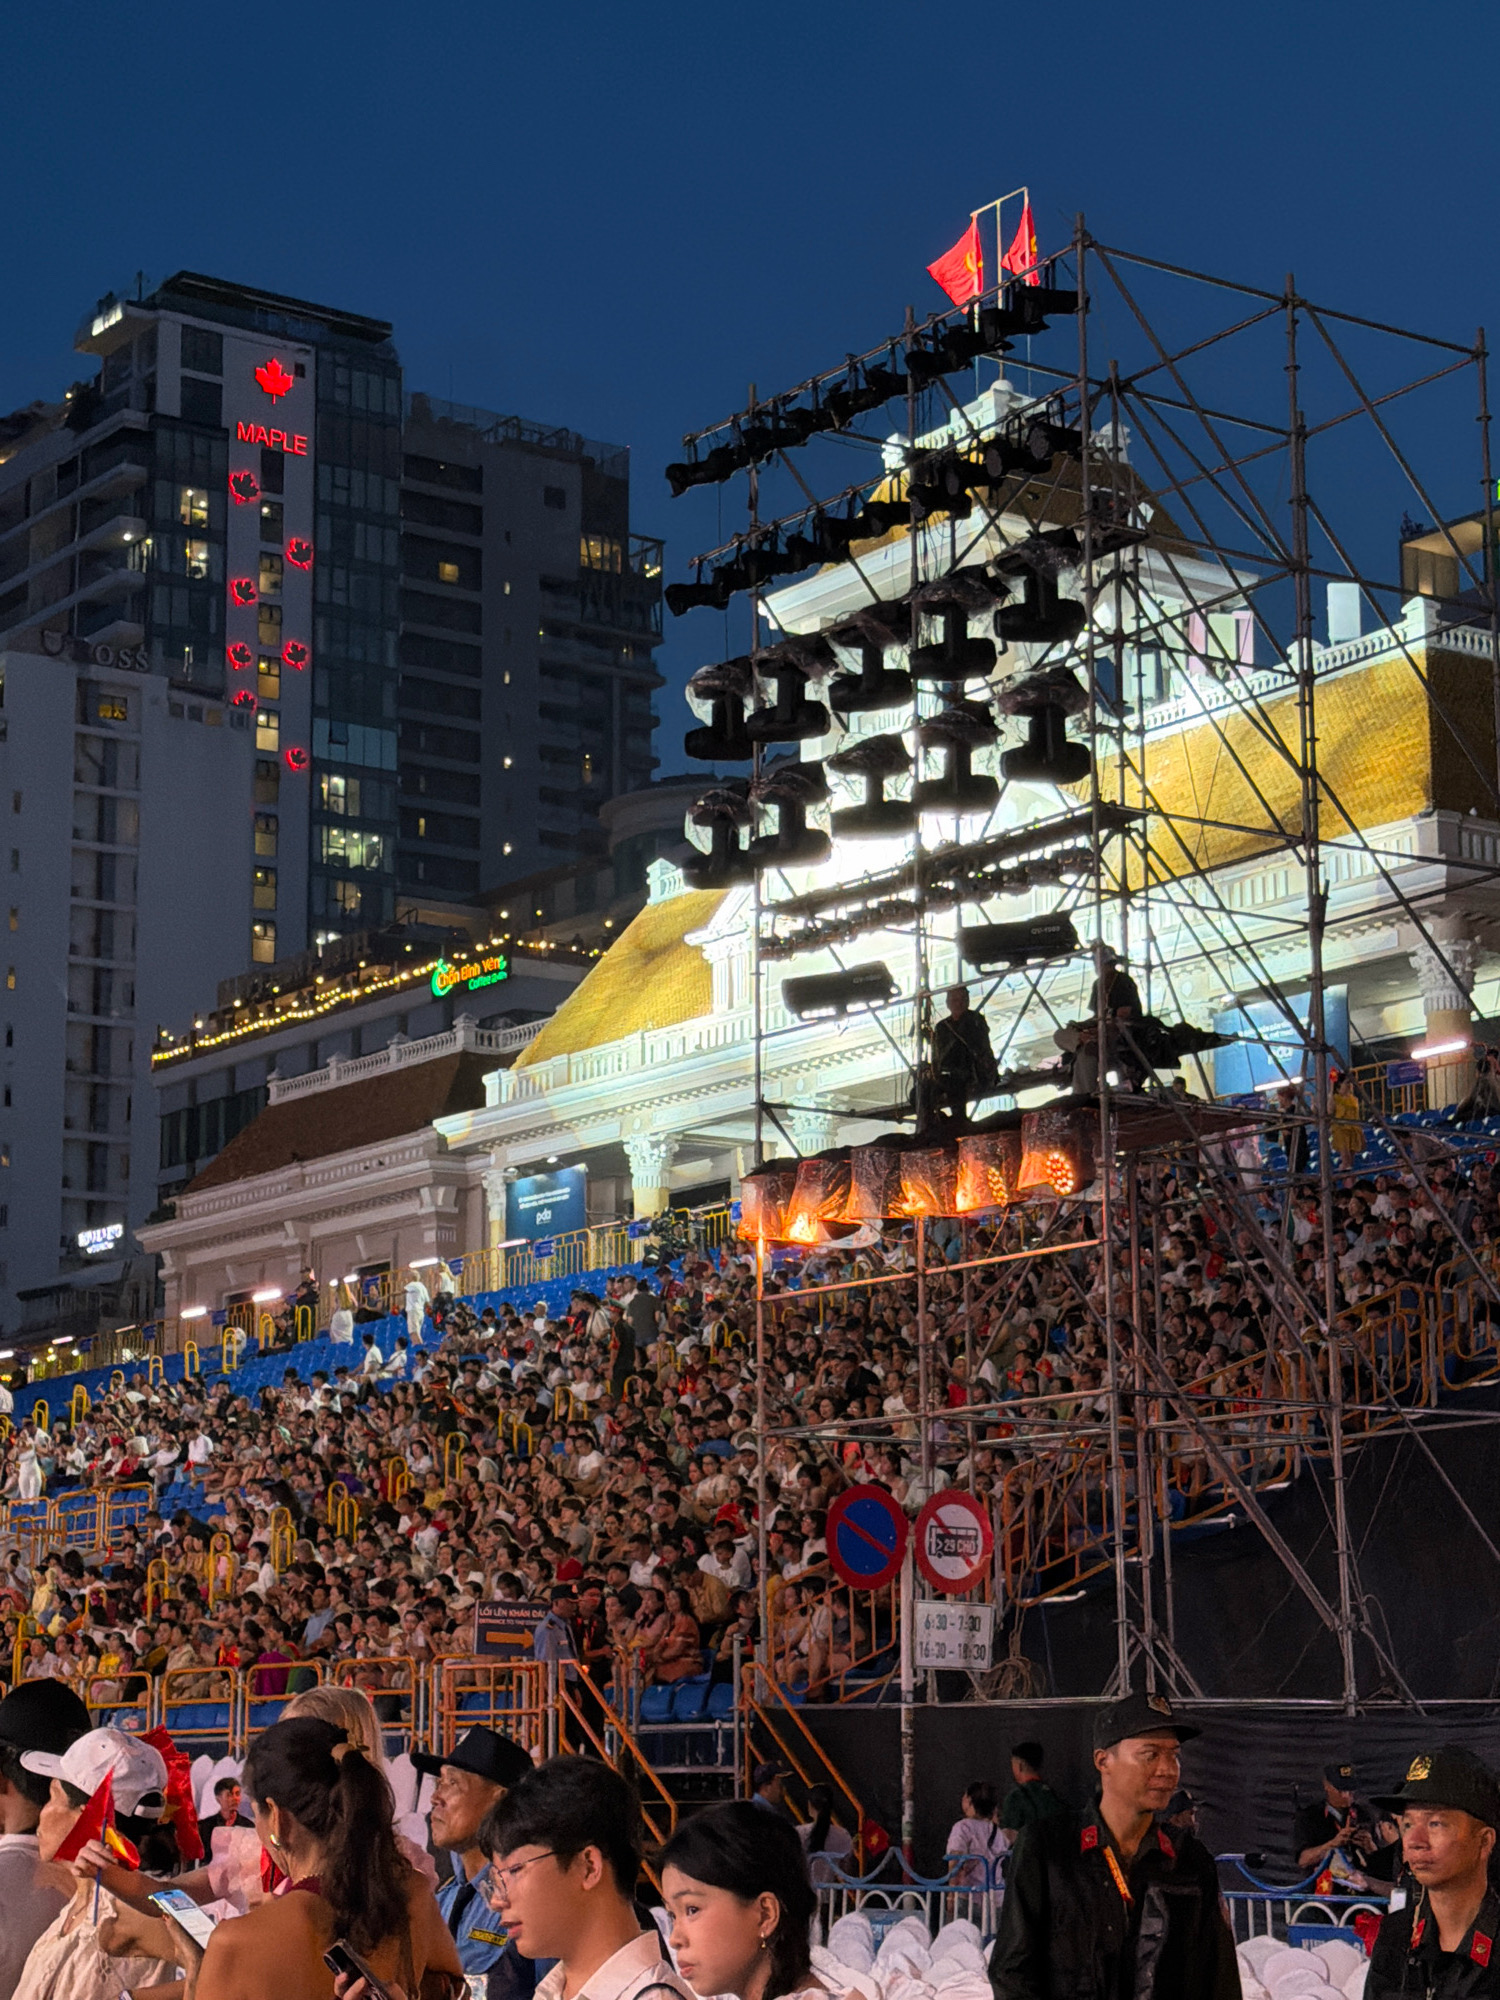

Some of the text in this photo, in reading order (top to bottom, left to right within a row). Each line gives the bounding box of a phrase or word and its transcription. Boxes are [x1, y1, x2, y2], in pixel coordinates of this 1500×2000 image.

[237, 421, 308, 456] MAPLE
[944, 1538, 956, 1553] 29
[924, 1613, 947, 1631] 6:30
[958, 1615, 981, 1632] 7:30
[919, 1641, 947, 1659] 16:30
[957, 1643, 986, 1661] 18:30
